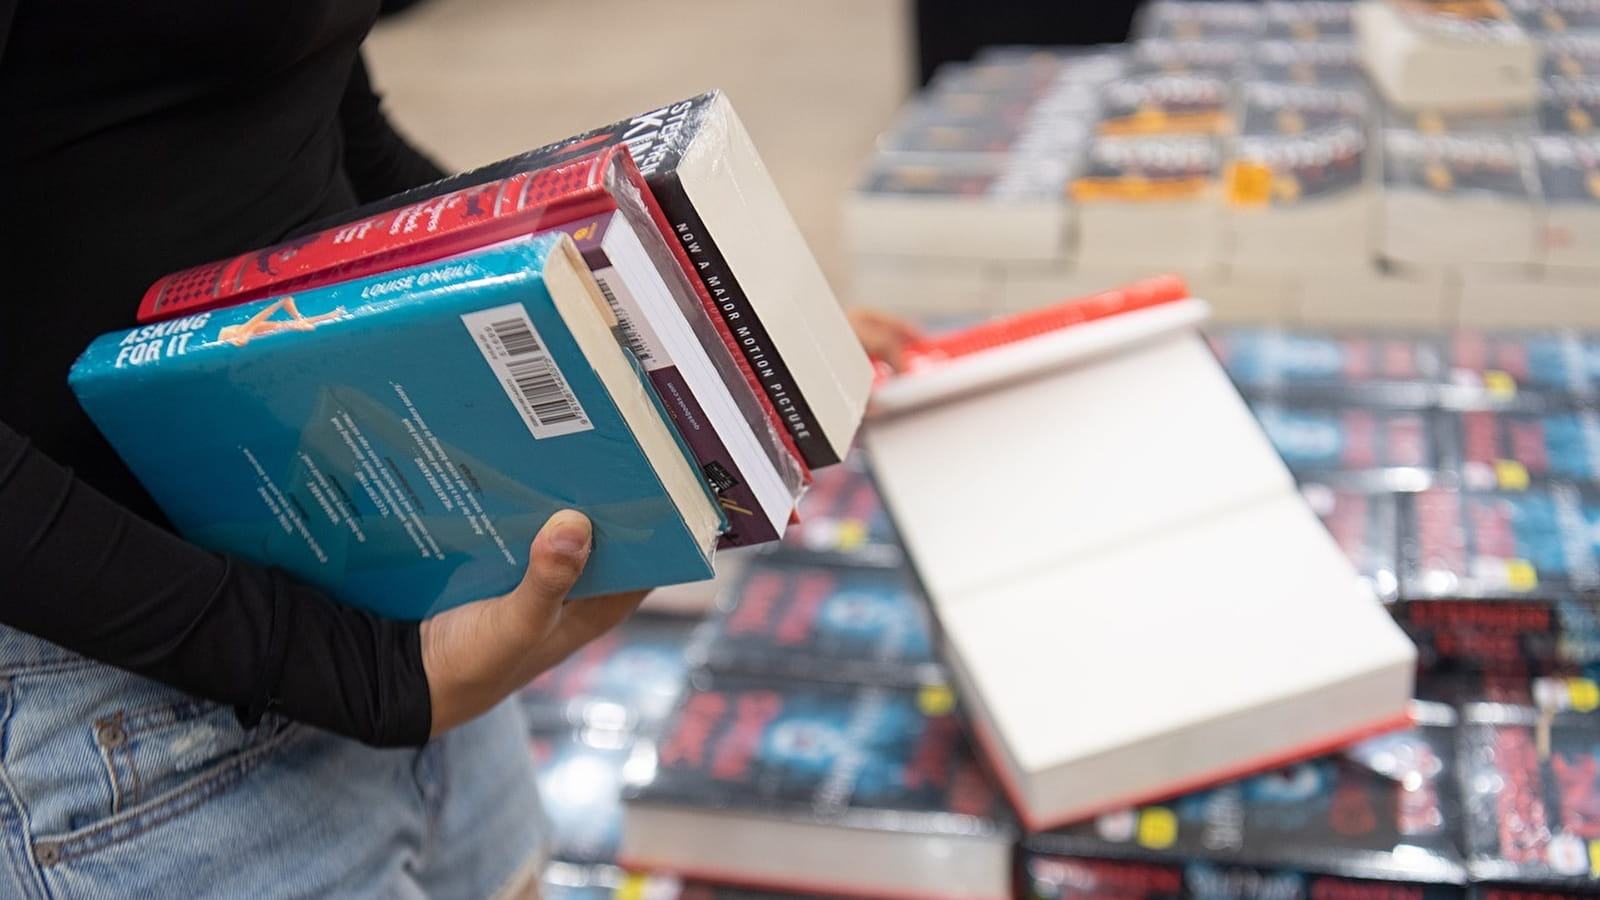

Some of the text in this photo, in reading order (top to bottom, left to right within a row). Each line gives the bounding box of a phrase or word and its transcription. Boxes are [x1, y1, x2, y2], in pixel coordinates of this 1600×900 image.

[622, 108, 670, 162] KIN
[361, 274, 414, 299] LOUISE
[119, 312, 212, 347] ASKING
[676, 222, 812, 439] NOW A MAJOR MOTION PICTURE
[115, 332, 195, 369] FOR IT
